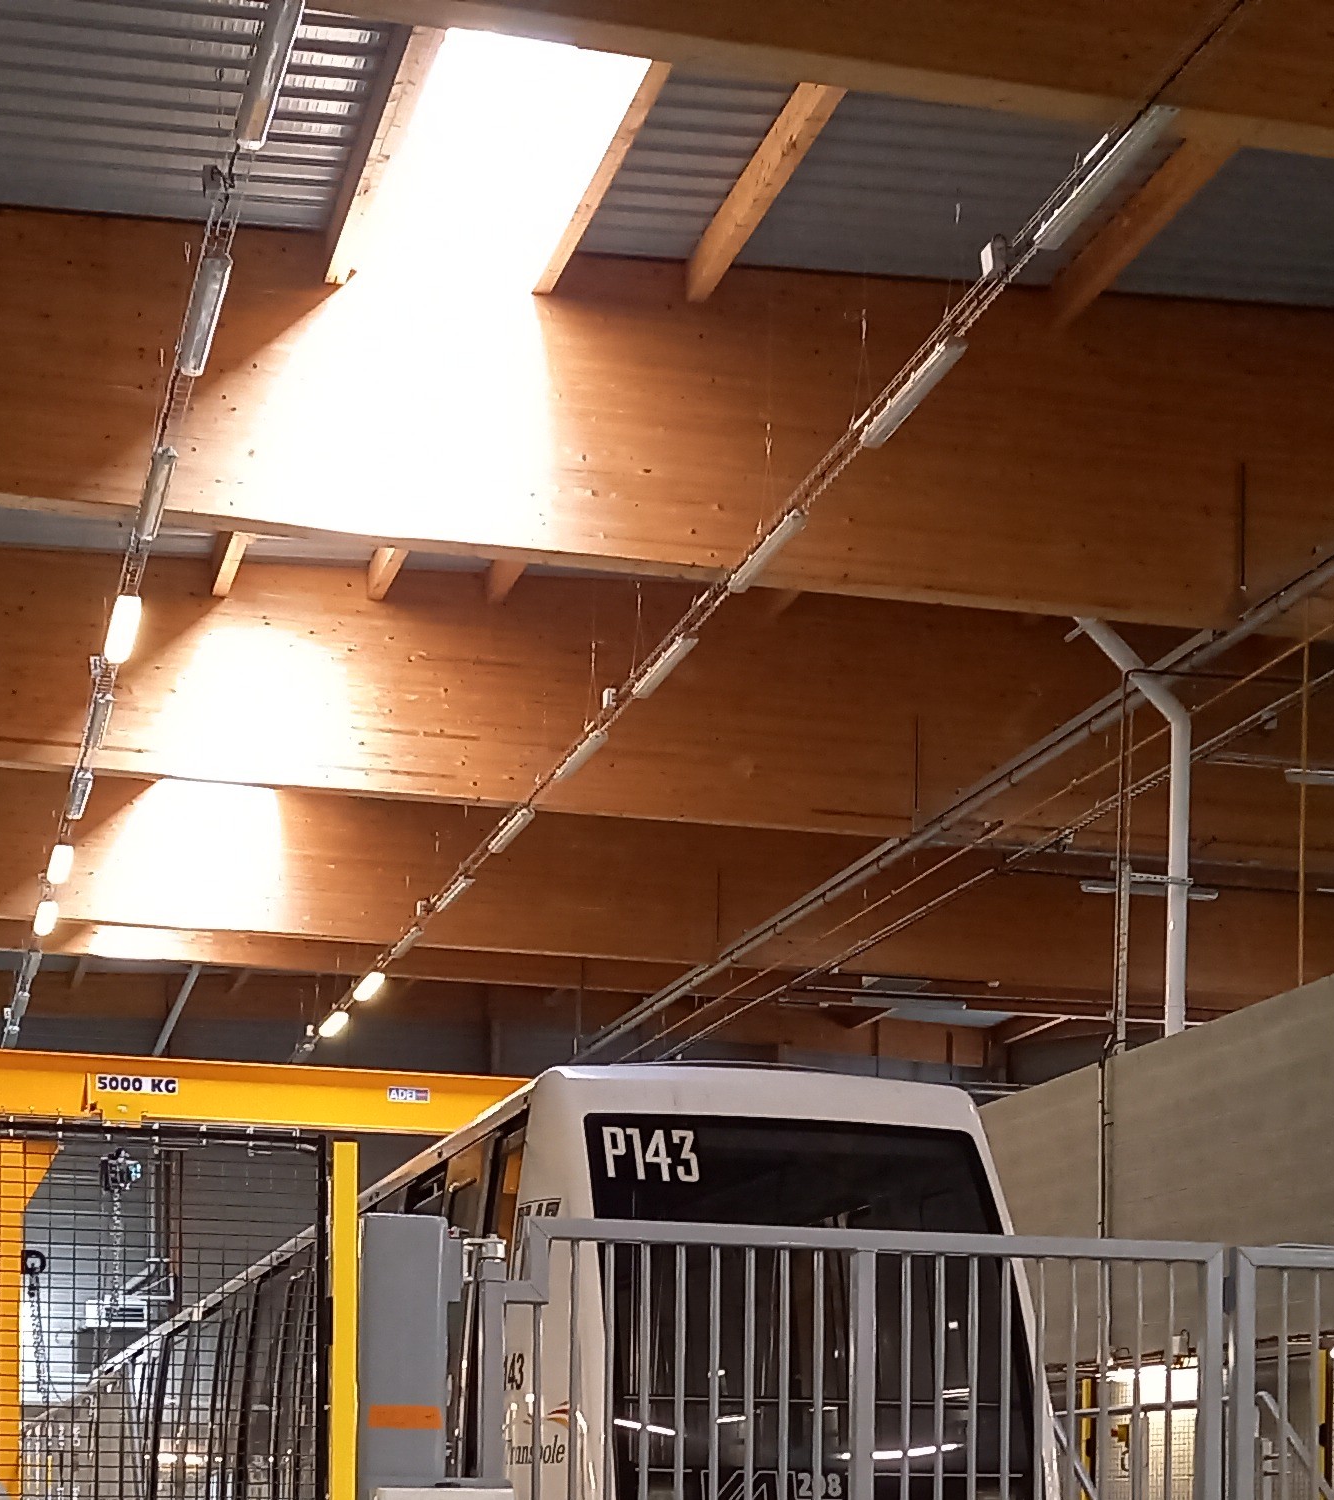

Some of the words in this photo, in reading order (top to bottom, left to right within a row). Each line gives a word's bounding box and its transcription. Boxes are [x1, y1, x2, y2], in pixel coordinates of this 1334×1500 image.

[97, 1076, 143, 1092] 5000
[150, 1079, 177, 1093] KG
[601, 1126, 700, 1183] P143
